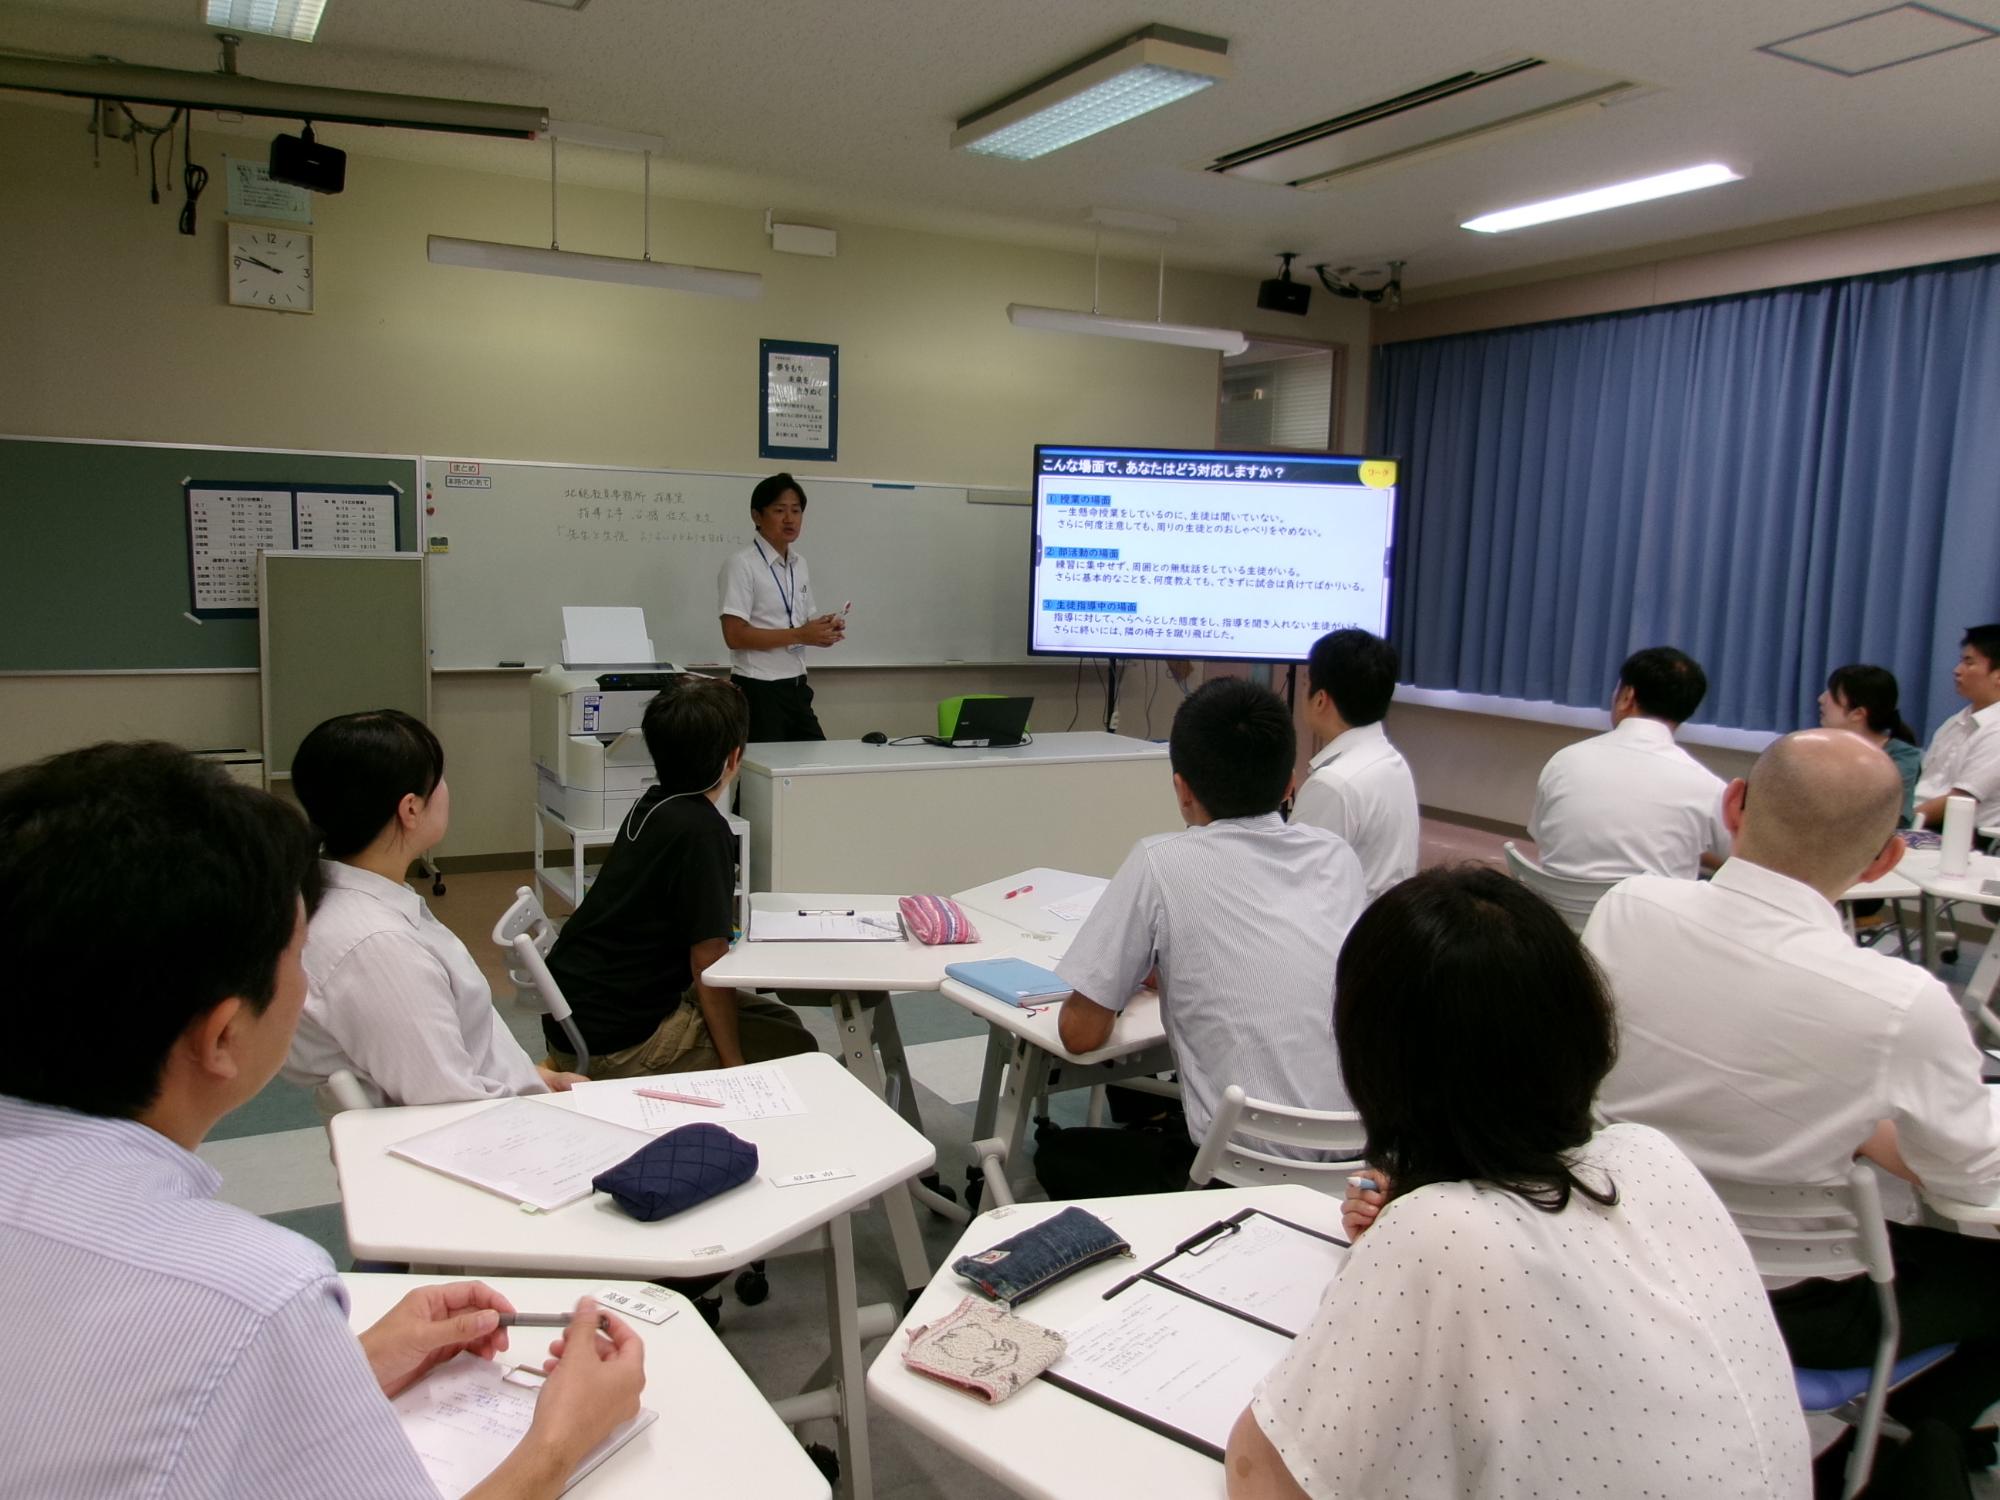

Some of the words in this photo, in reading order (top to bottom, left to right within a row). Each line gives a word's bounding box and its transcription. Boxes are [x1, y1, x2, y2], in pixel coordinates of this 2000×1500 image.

[267, 233, 277, 244] 12
[233, 259, 242, 270] 9
[303, 268, 311, 279] 3
[268, 294, 277, 305] 6
[453, 464, 477, 473] まとめ
[1042, 458, 1285, 479] こんな場面で、あなたはどう対応しますか？
[1060, 494, 1111, 506] 授業の場面
[1057, 506, 1286, 524] 一生懸命授業をしているのに、生徒は聞いていない。
[1056, 519, 1323, 538] さらに何度注意しても、周りの生徒とのおしゃべりをやめない。
[1058, 548, 1119, 559] 部活動の場面
[1055, 559, 1300, 577] 練習に集中せず、周囲との無駄話をしている生徒がいる。
[1055, 572, 1366, 592] さらに基本的なことを、何度教えても、できずに試合は負けてばかりいる。
[1056, 600, 1137, 612] 生徒指導中の場面
[1053, 625, 1236, 640] さらに終いには、隣の椅子を蹴り飛ばした。
